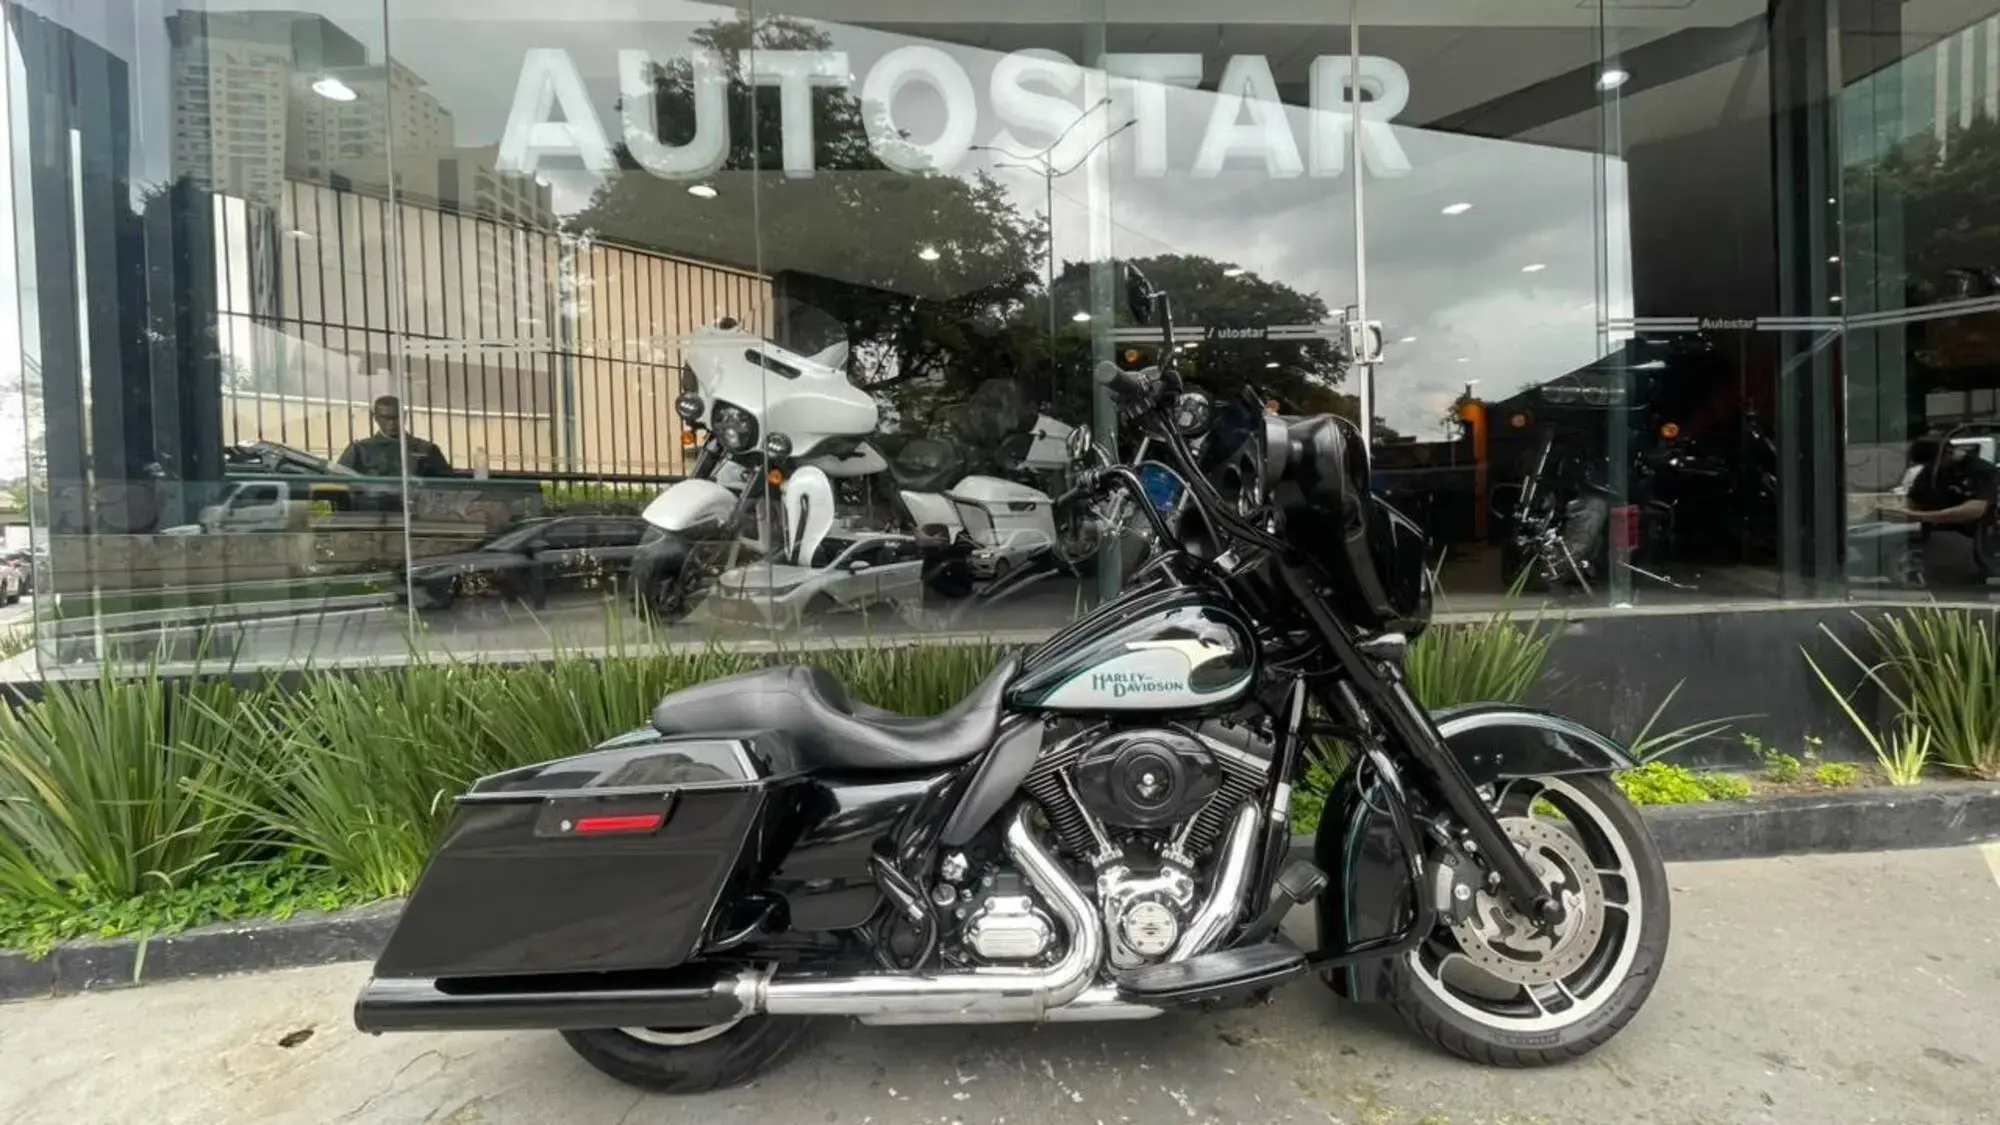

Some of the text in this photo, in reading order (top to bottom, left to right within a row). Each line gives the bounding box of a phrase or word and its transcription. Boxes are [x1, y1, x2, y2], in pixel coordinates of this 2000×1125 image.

[495, 45, 1412, 180] AUTOSTAR
[1701, 317, 1754, 329] Autostar
[1114, 681, 1183, 697] DAVIDSON
